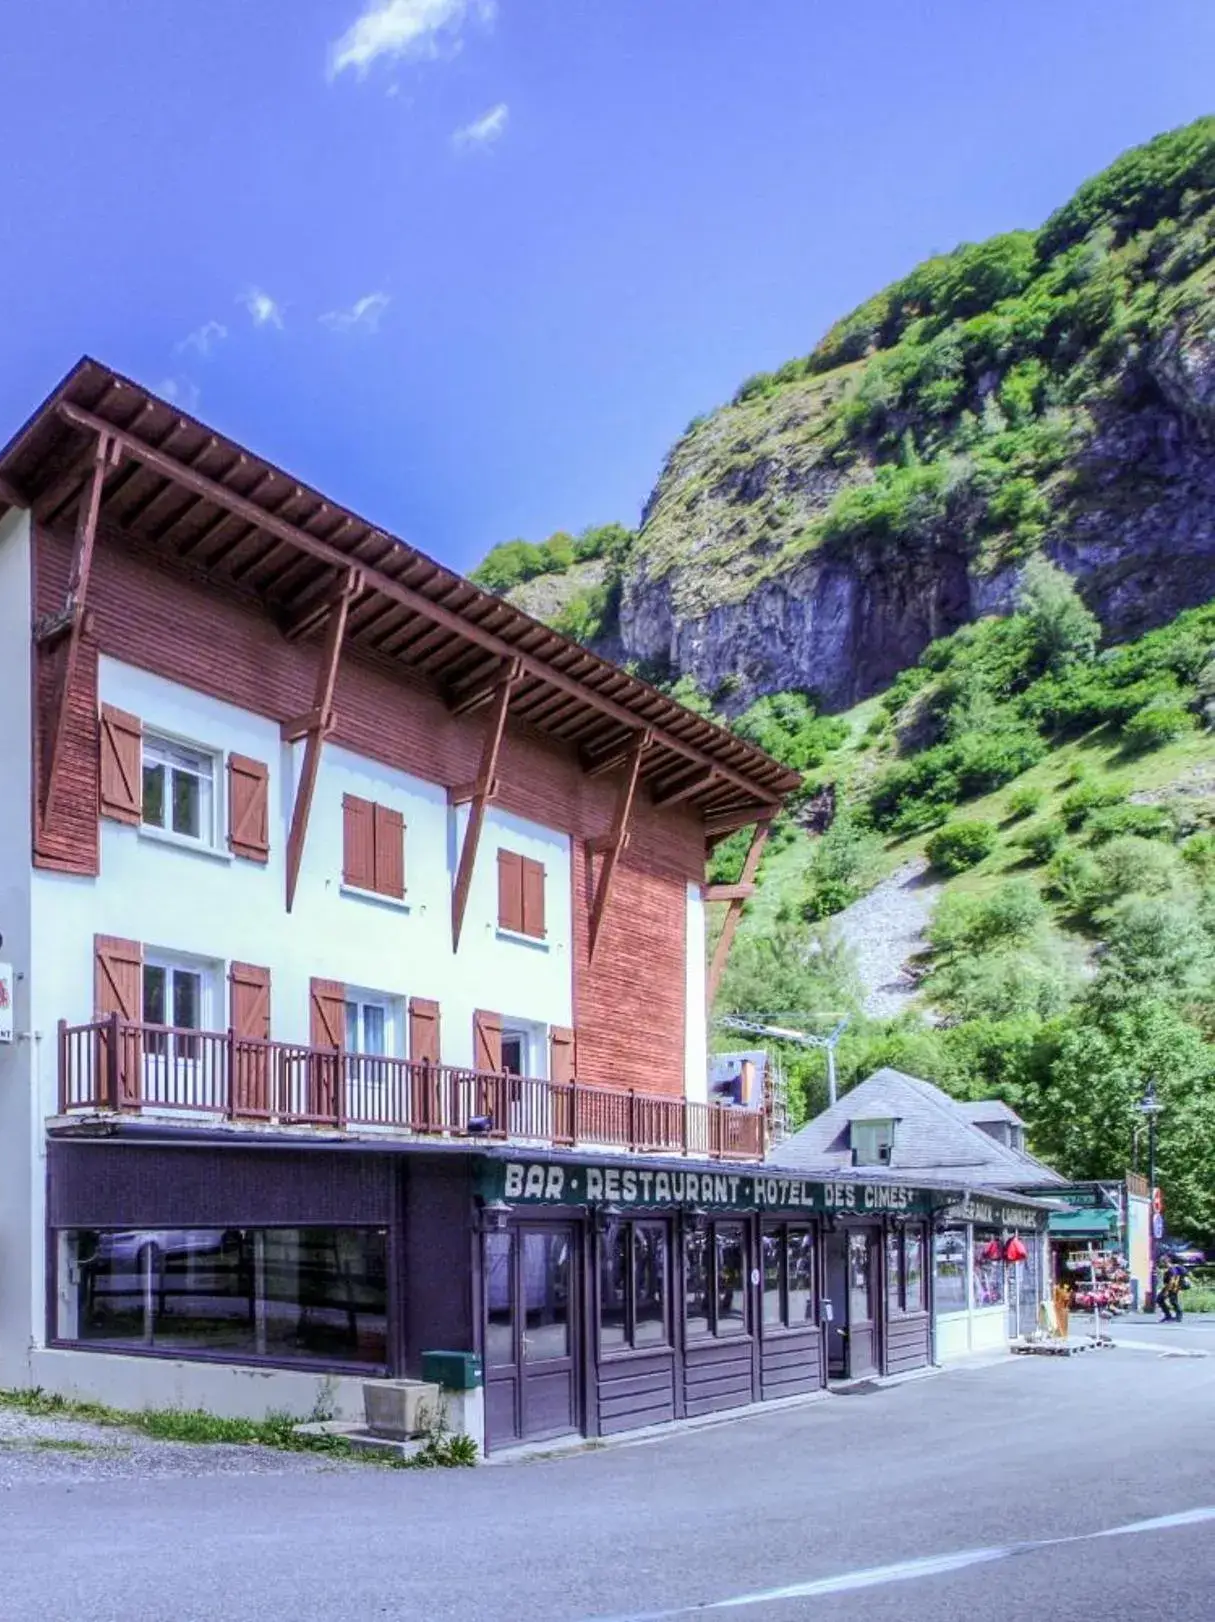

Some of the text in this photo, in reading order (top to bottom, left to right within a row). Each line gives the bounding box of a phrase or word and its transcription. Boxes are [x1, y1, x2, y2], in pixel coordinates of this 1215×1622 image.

[504, 1163, 907, 1209] BAR RESTAURANT HOTEL DES CIMES
